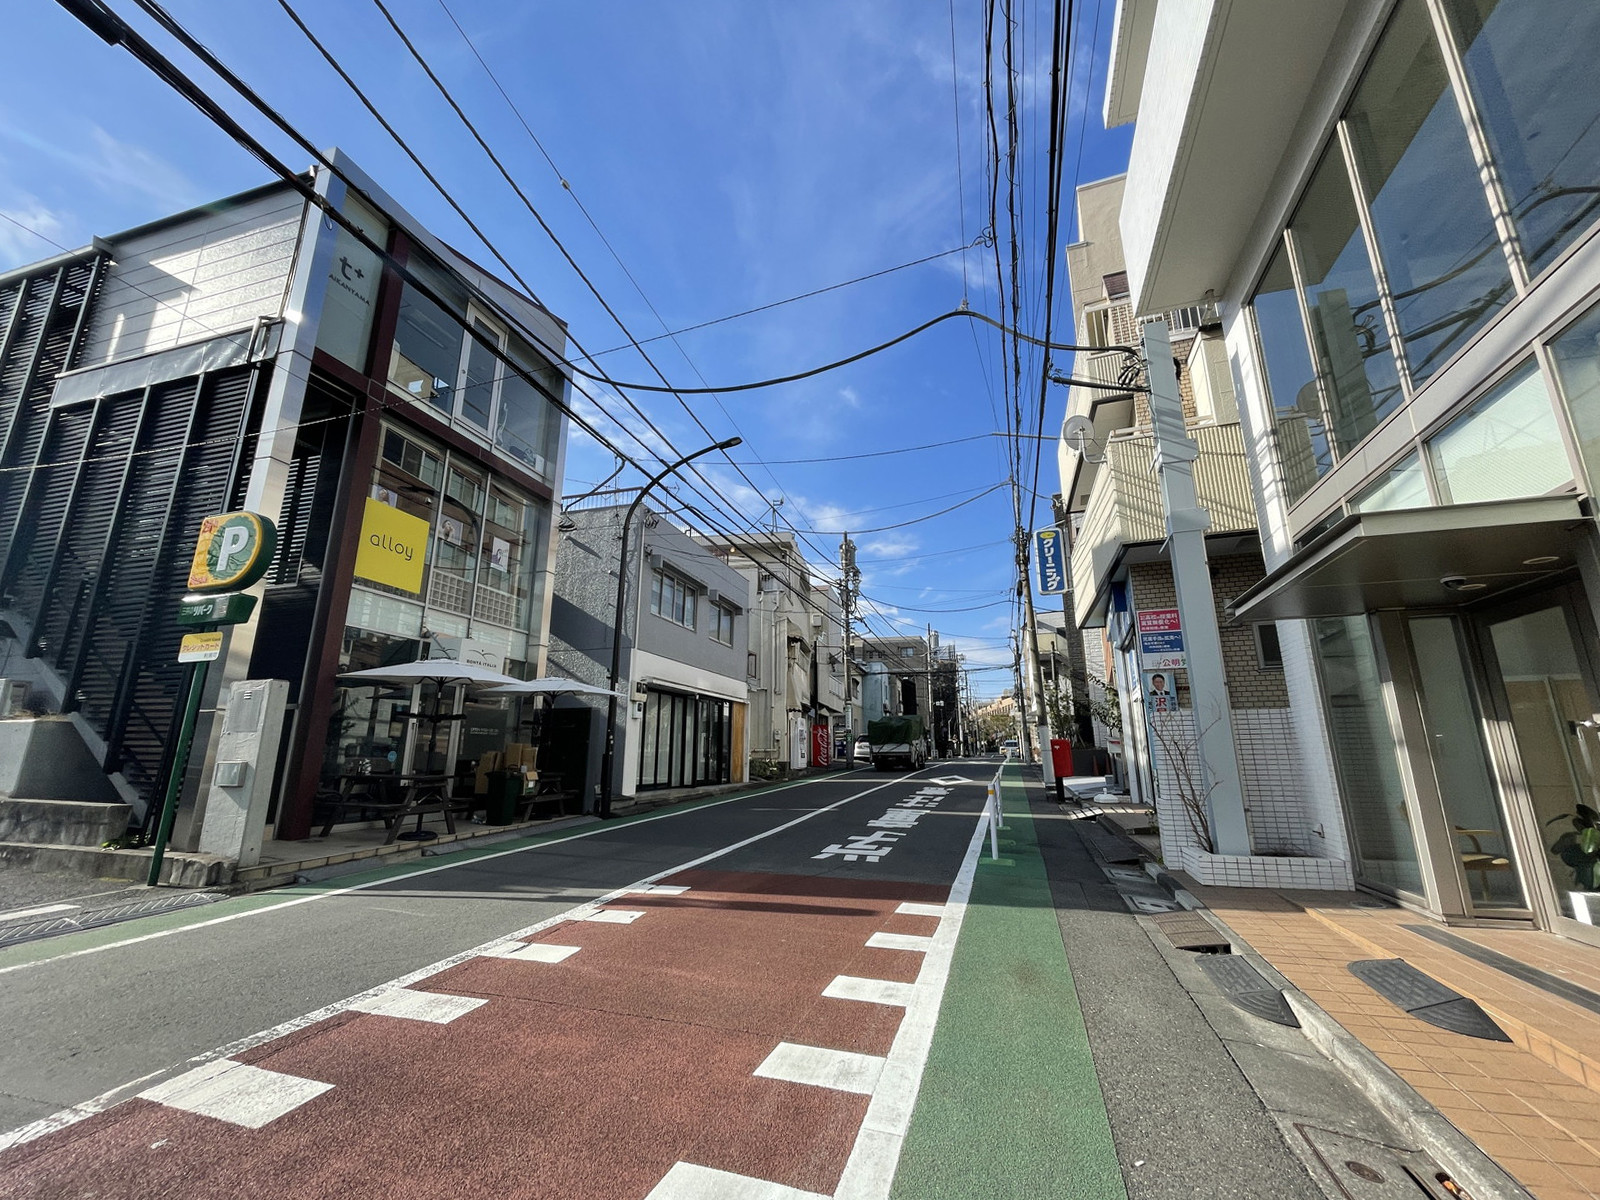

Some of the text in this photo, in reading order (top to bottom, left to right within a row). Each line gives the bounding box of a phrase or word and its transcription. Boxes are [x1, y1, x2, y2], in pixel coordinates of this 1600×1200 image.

[216, 526, 249, 571] P
[369, 533, 414, 562] alloy
[1043, 538, 1061, 591] クリーニング
